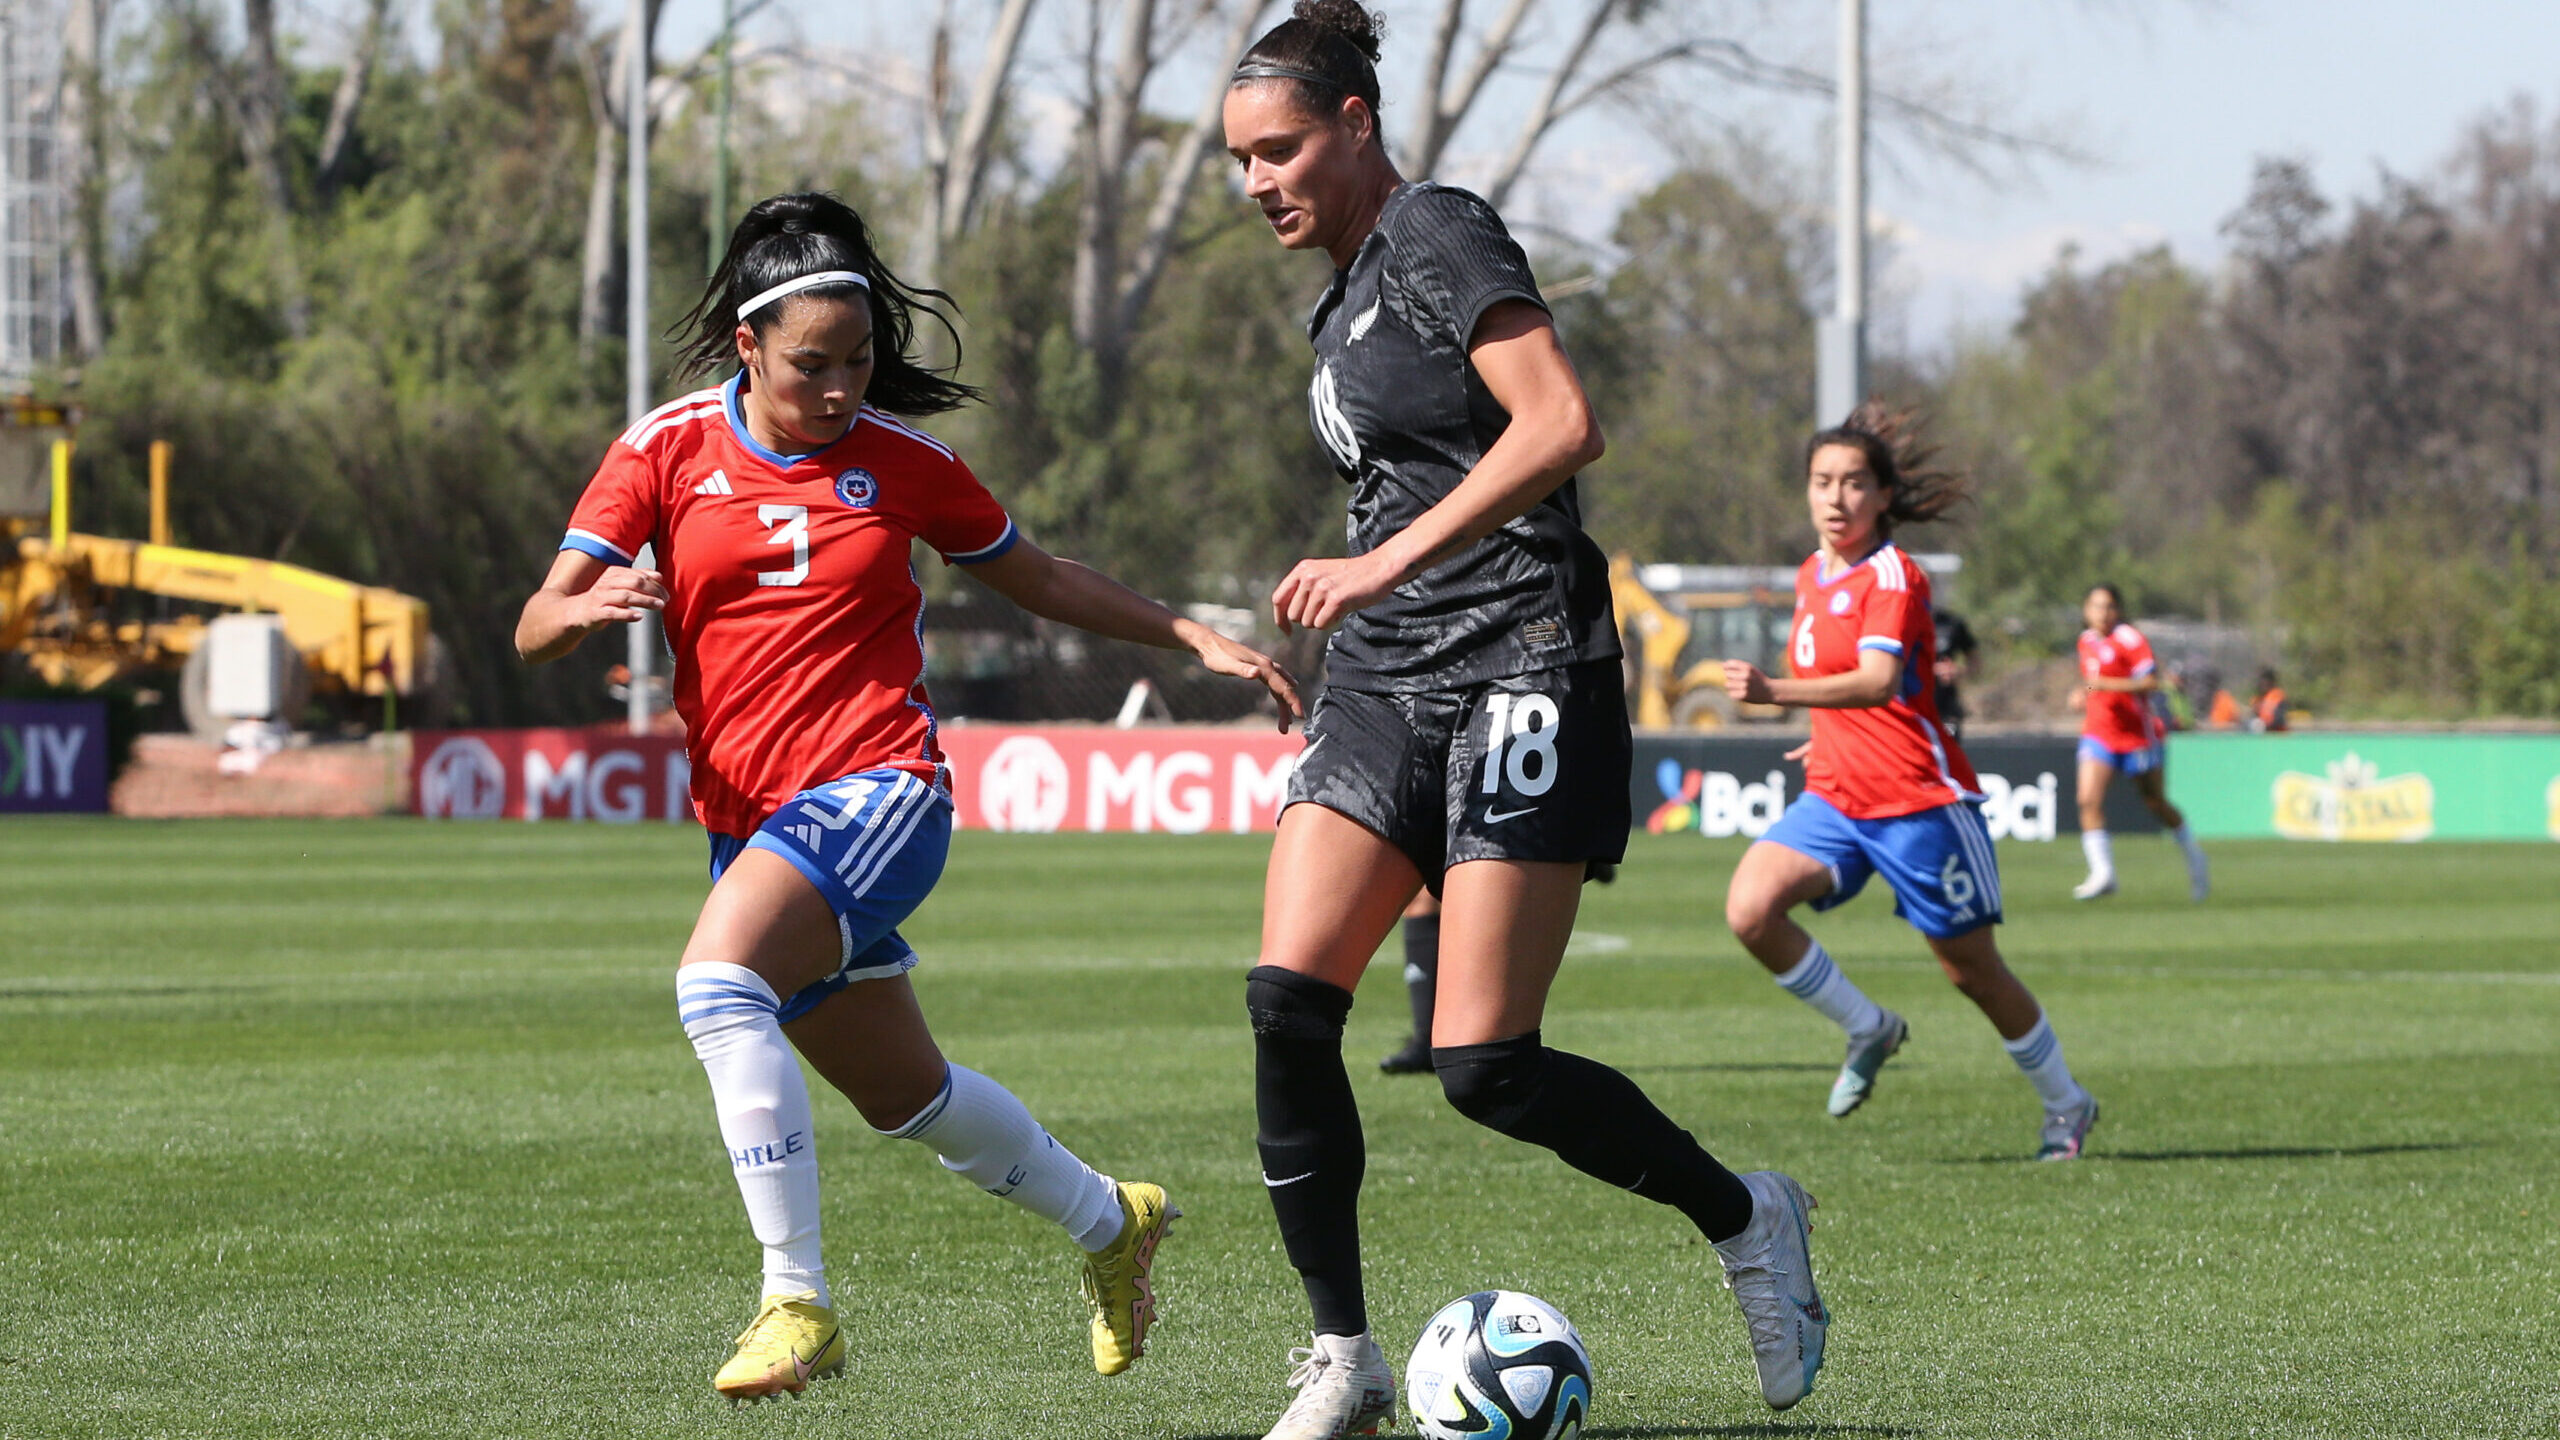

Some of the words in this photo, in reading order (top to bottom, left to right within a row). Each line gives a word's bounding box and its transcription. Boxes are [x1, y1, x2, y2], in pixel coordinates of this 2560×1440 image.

[1311, 363, 1362, 470] 18
[757, 504, 810, 587] 3
[1794, 613, 1816, 668] 6
[1481, 692, 1560, 797] 18
[523, 748, 645, 823] MG
[1087, 750, 1214, 834] MG
[1700, 769, 1787, 838] Bci
[1941, 853, 1976, 904] 6
[727, 1131, 803, 1168] HILE
